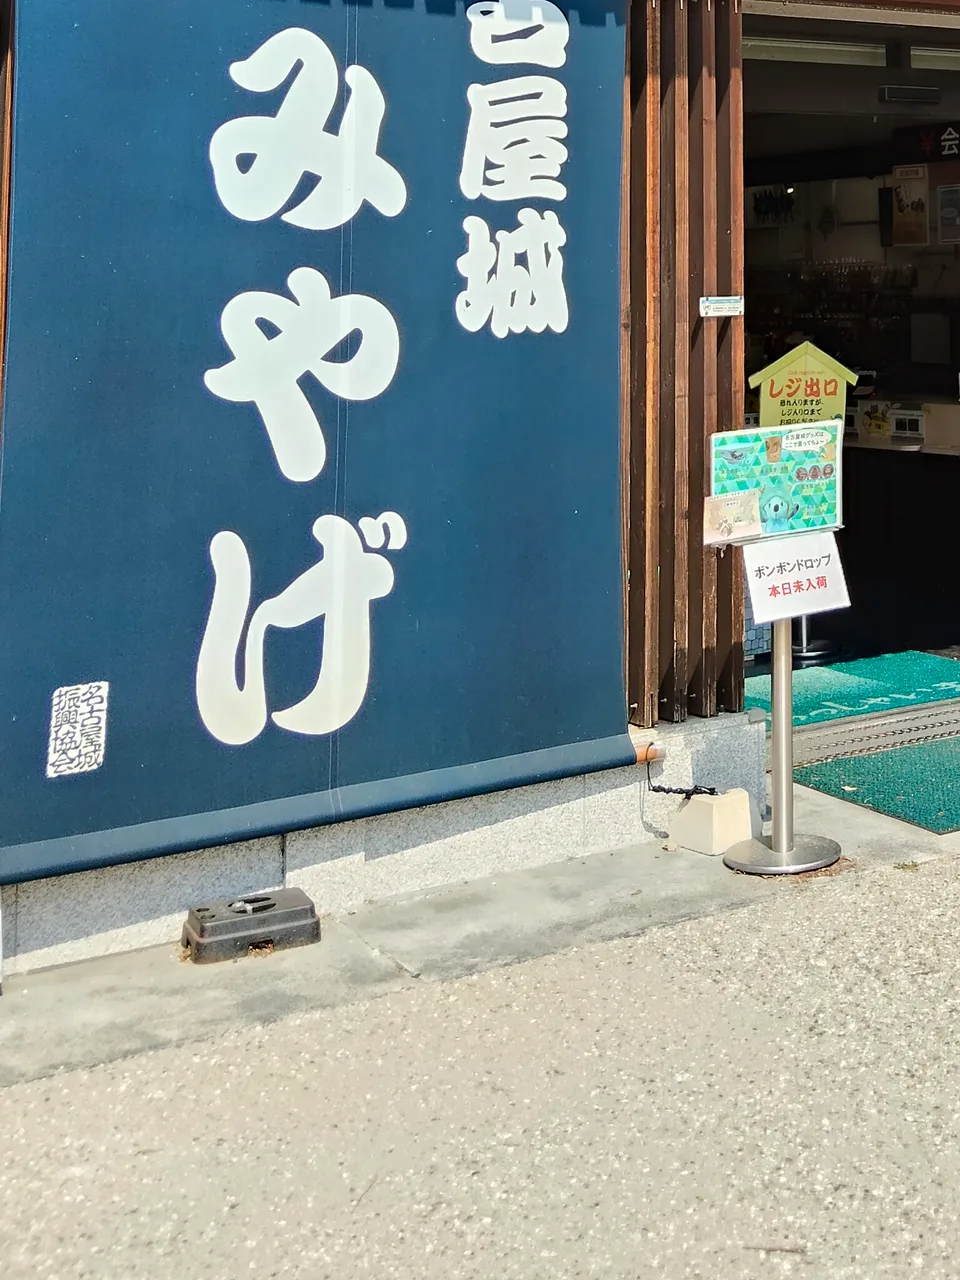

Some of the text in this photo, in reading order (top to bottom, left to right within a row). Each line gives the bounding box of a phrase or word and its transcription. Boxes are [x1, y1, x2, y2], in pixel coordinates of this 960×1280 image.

[769, 377, 839, 399] レジ出口
[768, 575, 828, 598] 本日未入荷
[74, 685, 105, 770] 名古屋城
